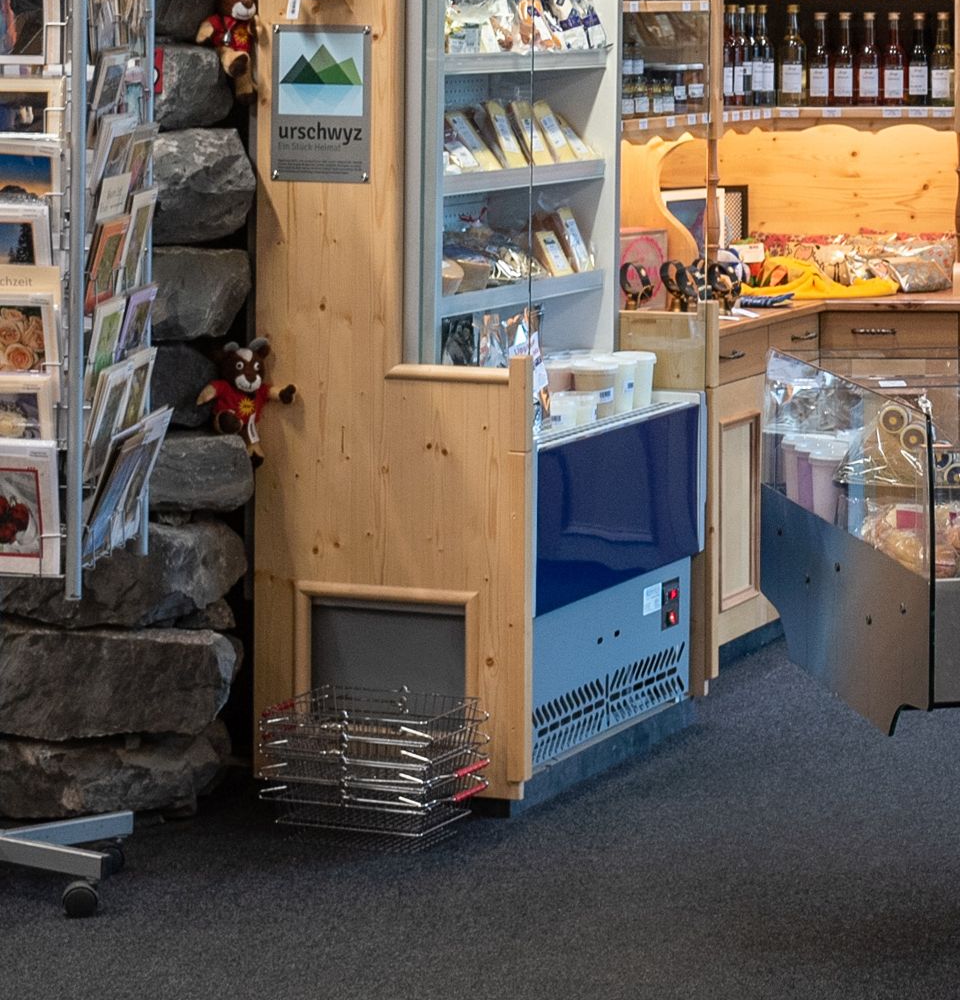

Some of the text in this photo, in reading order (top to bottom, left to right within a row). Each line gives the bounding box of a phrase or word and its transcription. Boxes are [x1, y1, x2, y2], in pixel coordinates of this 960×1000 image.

[278, 121, 362, 146] urschwyz
[278, 142, 290, 151] Ein
[315, 142, 341, 152] Heimat
